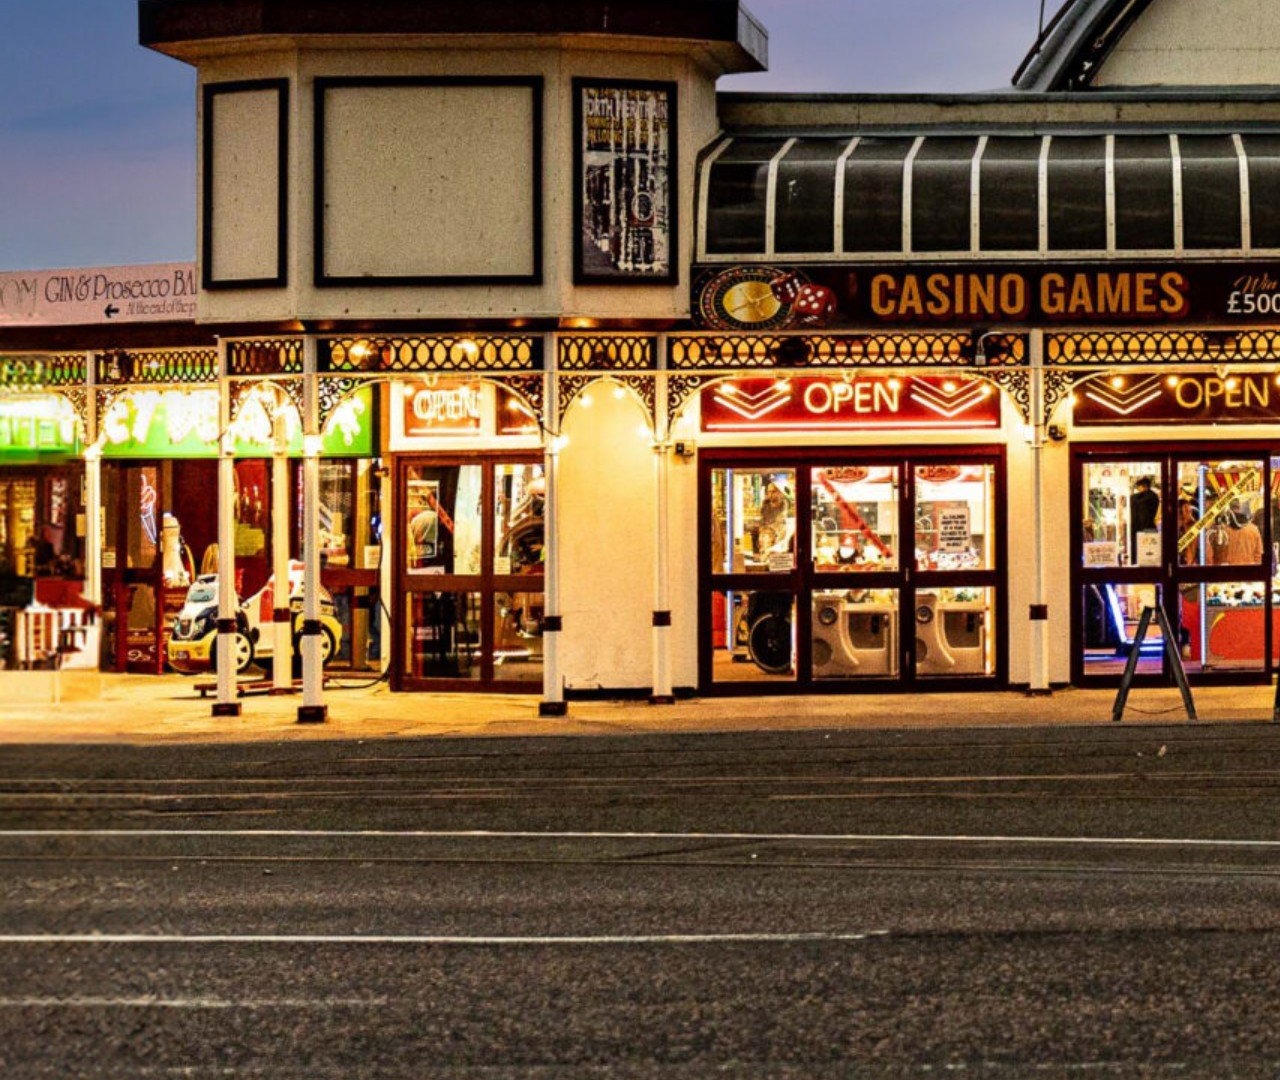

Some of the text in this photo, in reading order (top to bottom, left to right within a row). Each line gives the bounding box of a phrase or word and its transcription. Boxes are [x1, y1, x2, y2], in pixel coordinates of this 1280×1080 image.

[586, 97, 613, 117] ORTH
[44, 275, 75, 303] GIN
[75, 275, 91, 302] &
[93, 274, 171, 301] Prosecco
[173, 269, 197, 297] BA
[870, 271, 1187, 316] CASINO GAMES
[1234, 274, 1276, 295] Win
[413, 387, 480, 421] OPEN
[803, 381, 900, 415] OPEN
[1174, 377, 1270, 410] OPEN
